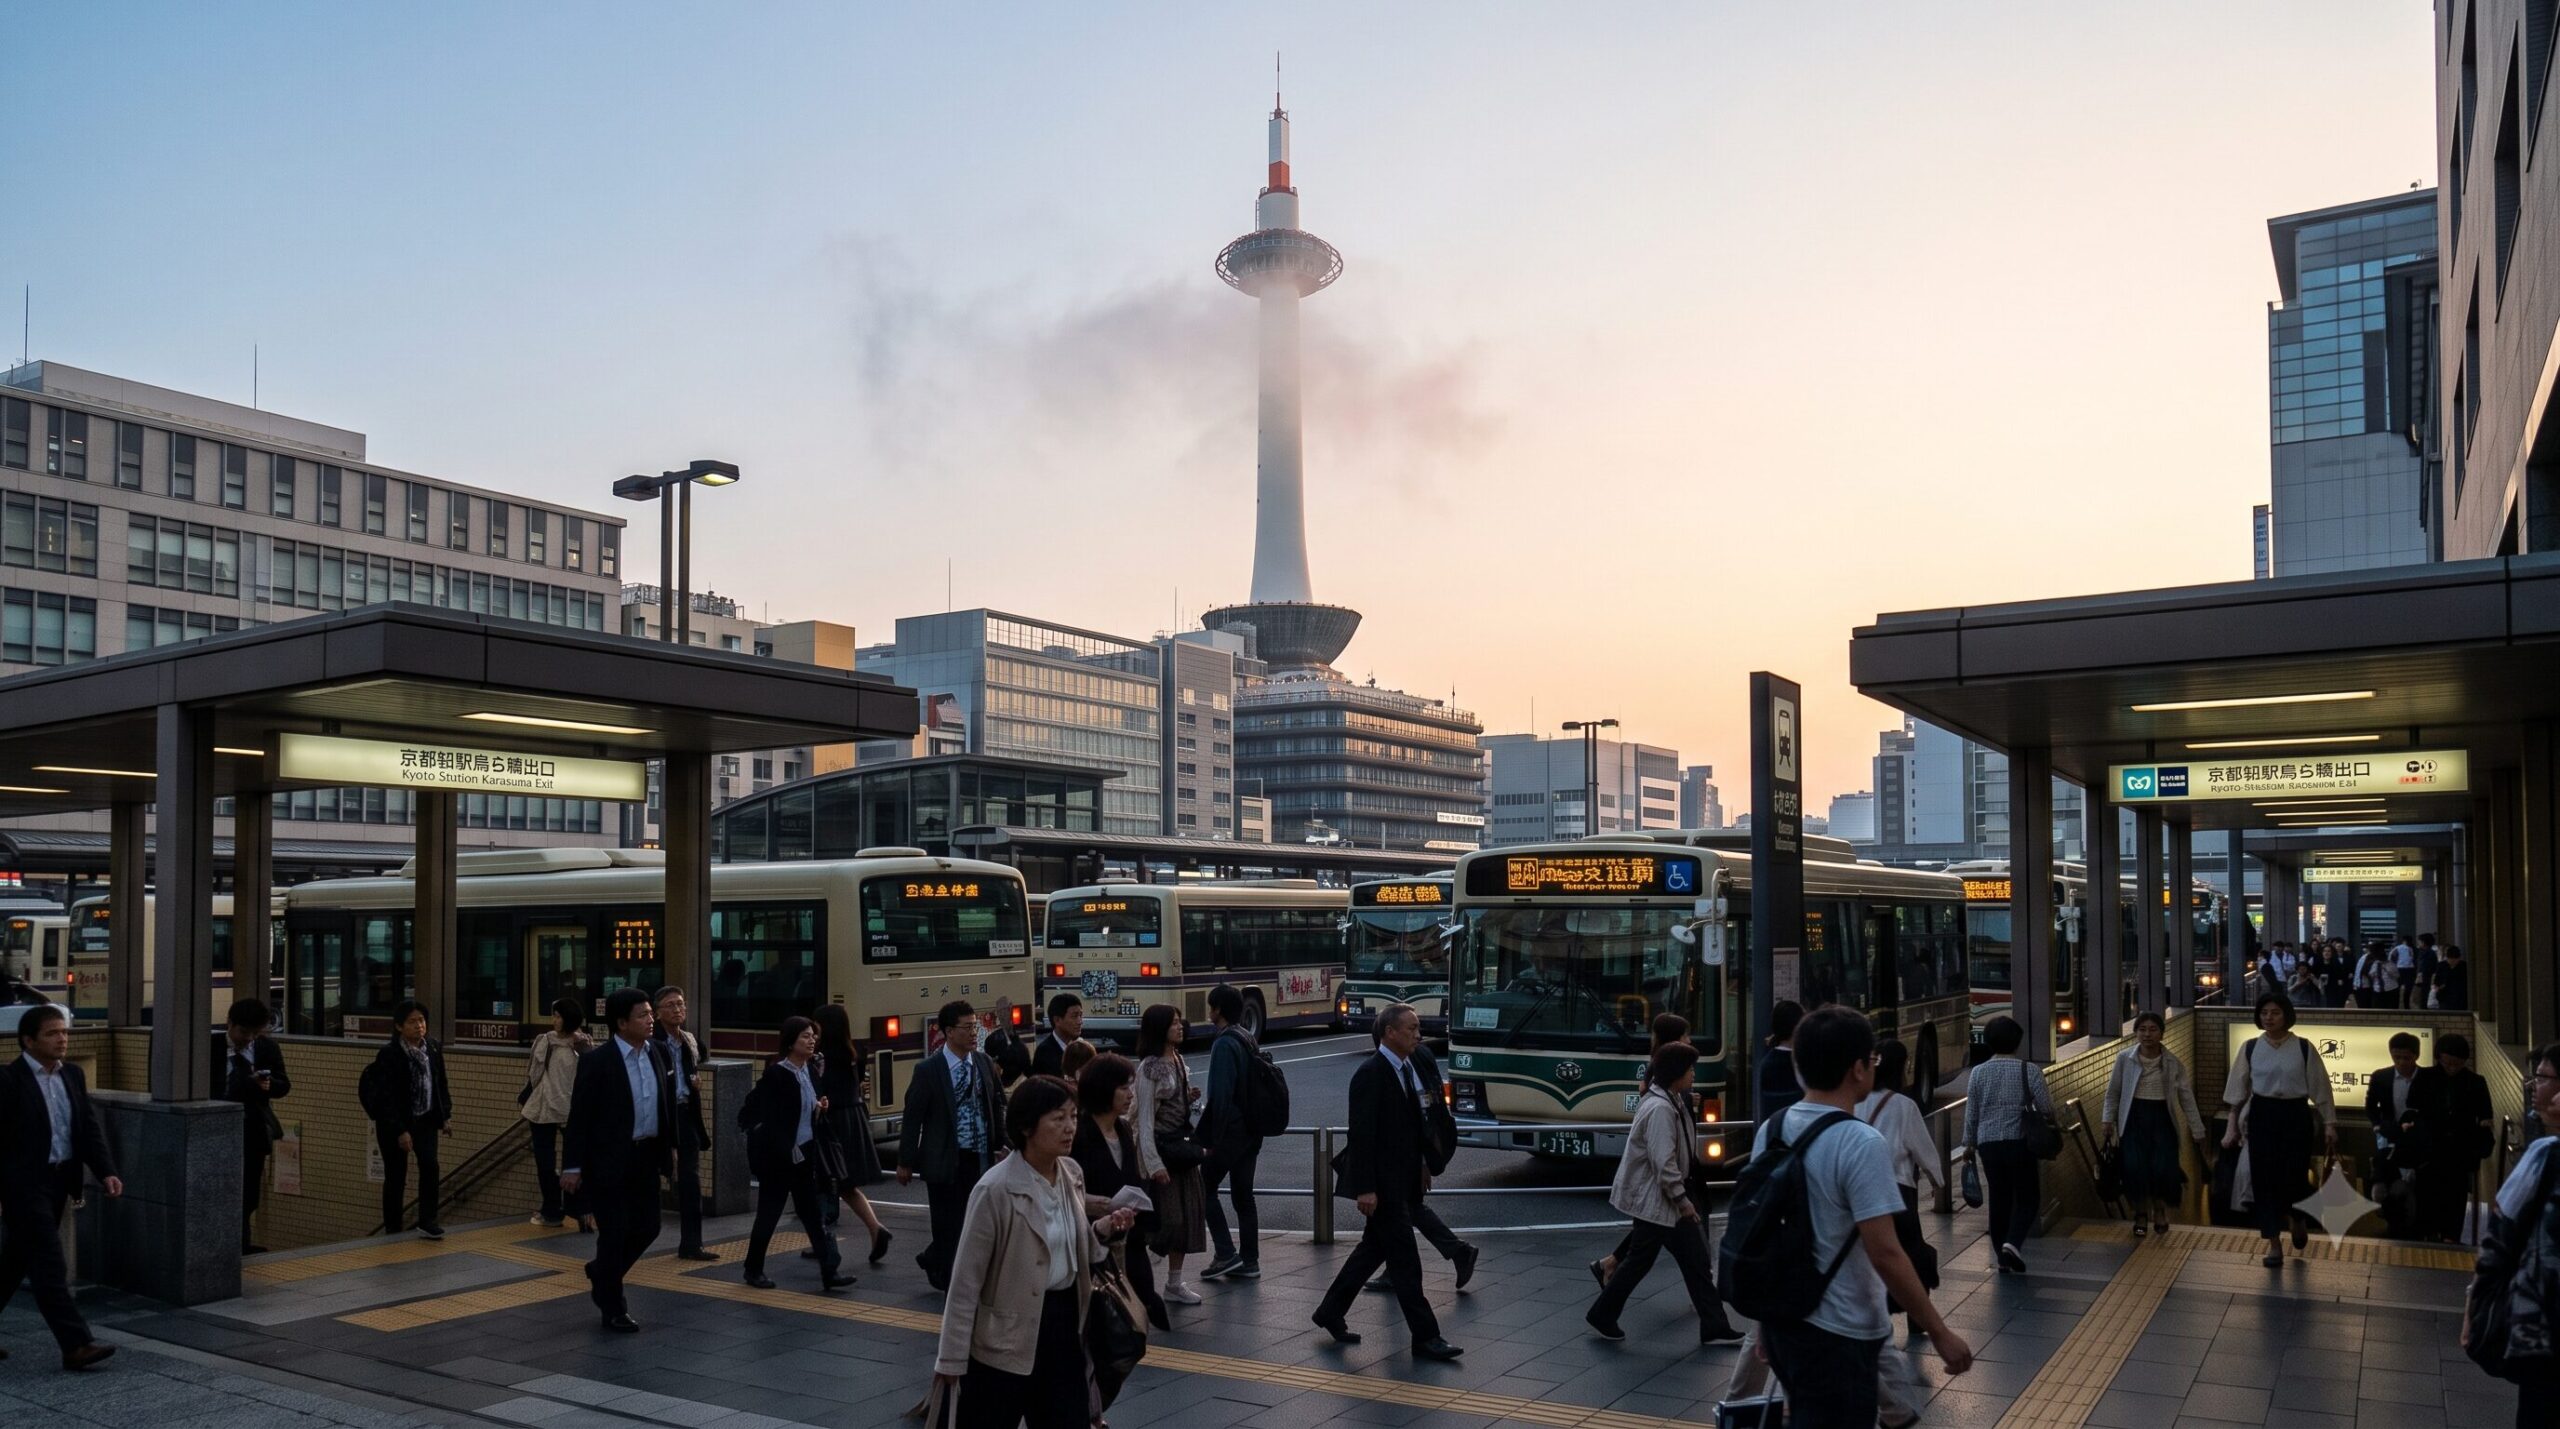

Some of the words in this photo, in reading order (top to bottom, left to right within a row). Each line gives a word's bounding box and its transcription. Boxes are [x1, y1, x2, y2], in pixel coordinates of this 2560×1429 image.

[402, 769, 436, 782] Kyoto
[482, 775, 532, 788] Karasuma
[535, 778, 554, 789] Exit
